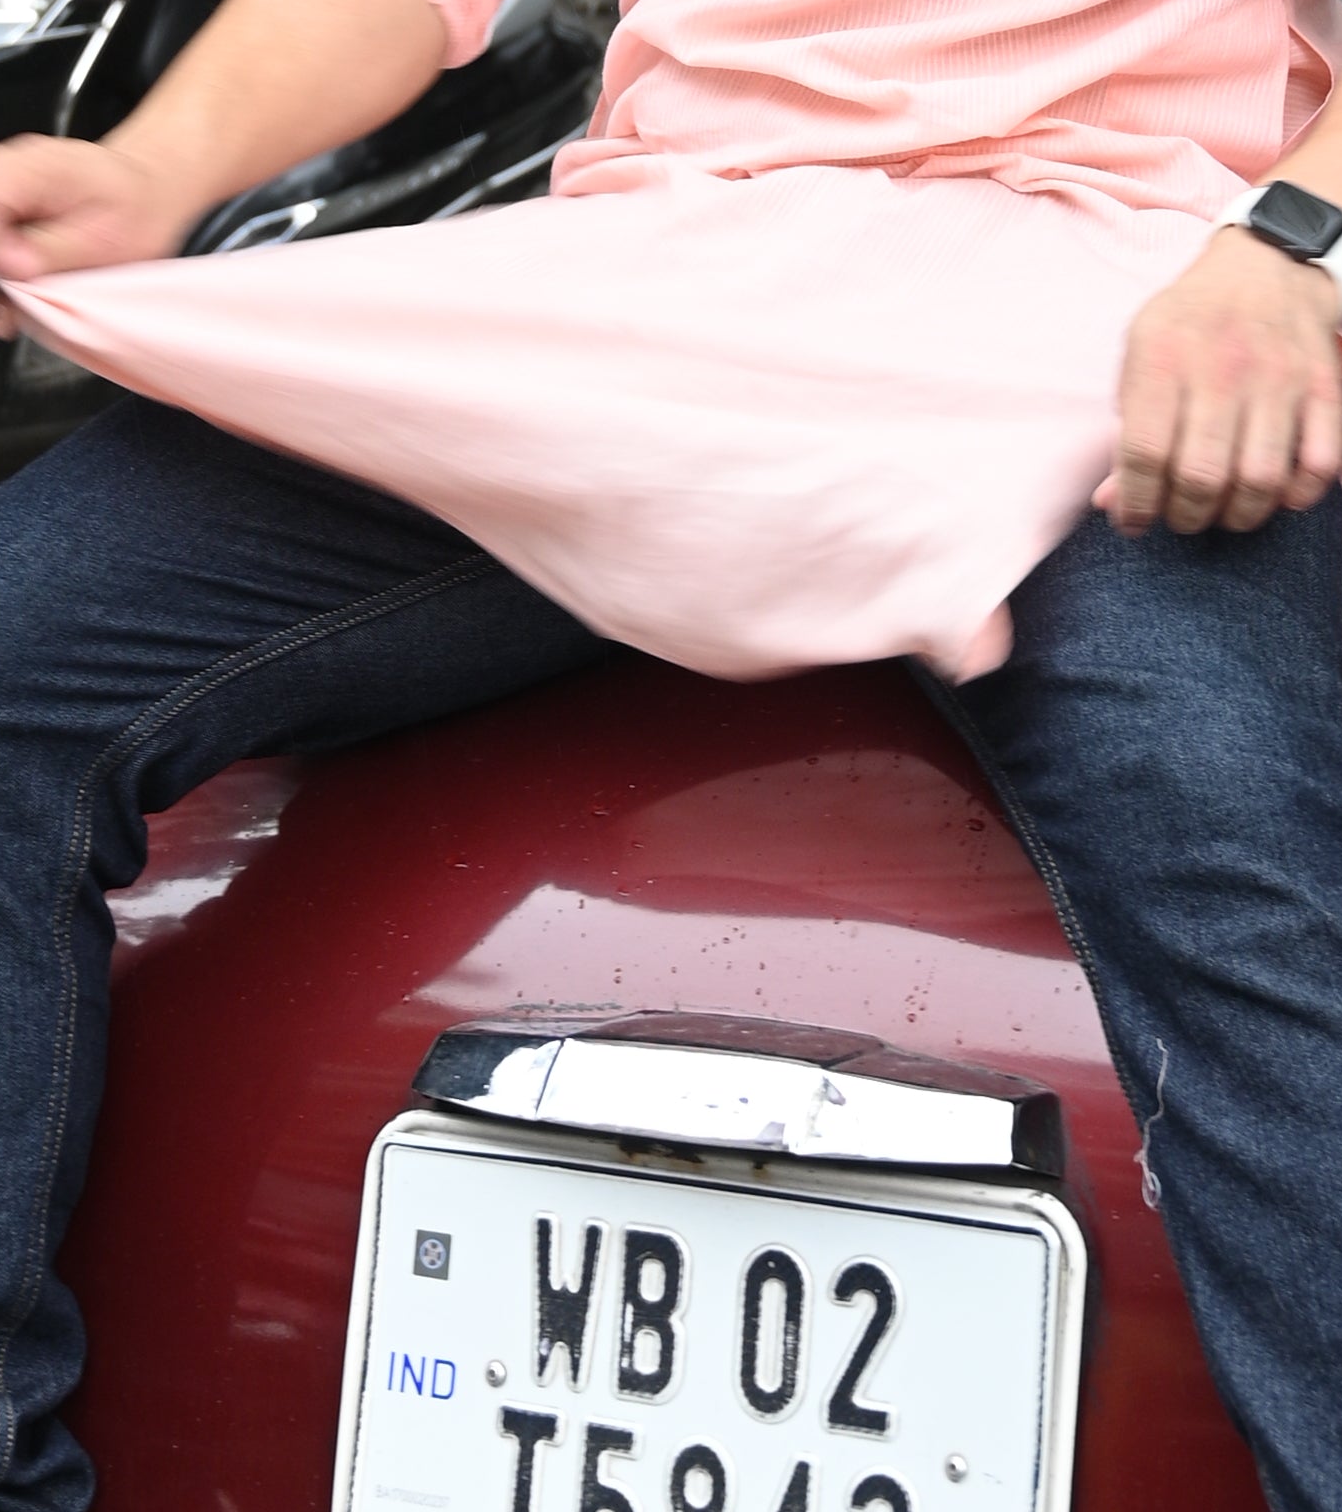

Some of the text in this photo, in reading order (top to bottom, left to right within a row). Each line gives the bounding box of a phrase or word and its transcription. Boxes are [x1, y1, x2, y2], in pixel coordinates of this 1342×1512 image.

[387, 1351, 458, 1402] IND
[533, 1214, 900, 1435] WB 02
